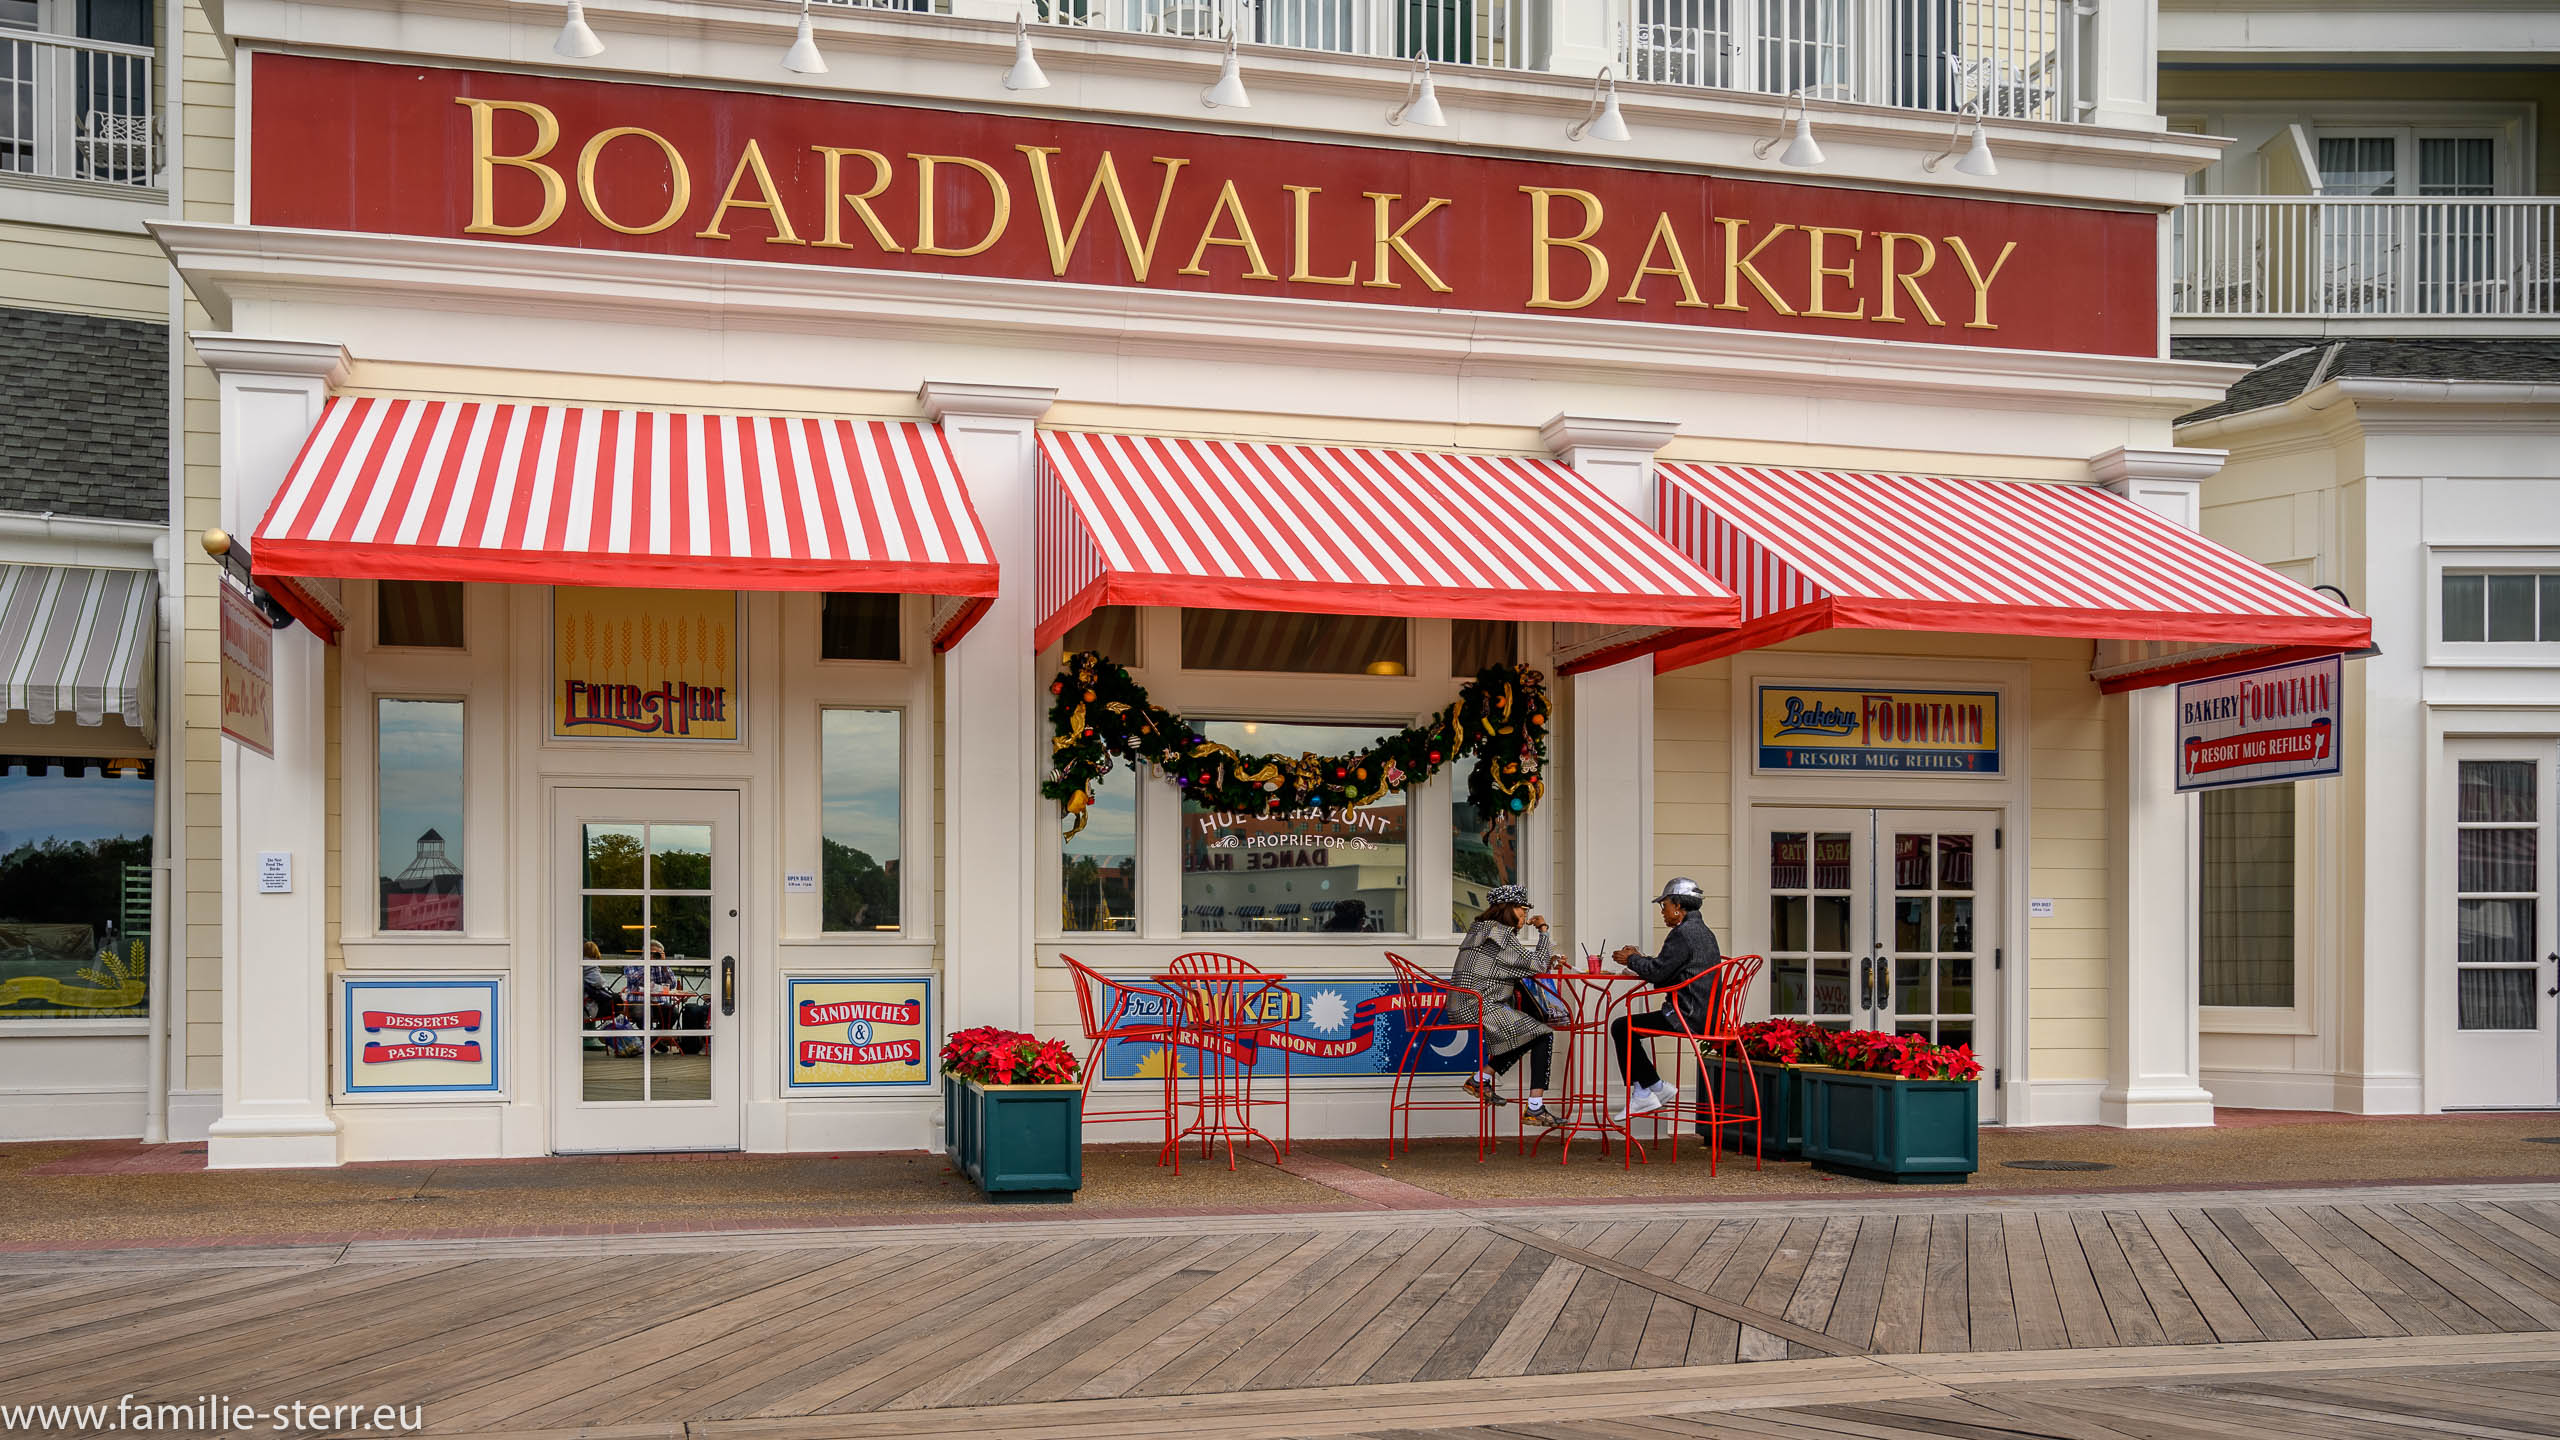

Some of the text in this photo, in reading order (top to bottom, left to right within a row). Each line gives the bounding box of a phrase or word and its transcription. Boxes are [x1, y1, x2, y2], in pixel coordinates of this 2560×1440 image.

[455, 96, 2018, 330] BOARDWALK BAKERY
[565, 680, 726, 734] ENTER HERE
[2184, 672, 2330, 728] BAKERY FOUNTAIN
[1774, 695, 1983, 746] Bakery FOUNTAIN
[2201, 734, 2312, 764] RESORT MUG REFILLS
[1800, 752, 1963, 768] RESORT MUG REFILLS
[1247, 834, 1345, 849] PROPRIETOR
[1119, 989, 1180, 1018] Fresh
[385, 1015, 459, 1027] DESSERTS
[809, 1004, 910, 1023] SANDWICHES
[418, 1031, 428, 1042] &
[855, 1024, 866, 1040] &
[388, 1046, 458, 1059] PASTRIES
[807, 1043, 913, 1062] FRESH SALADS
[1269, 1033, 1316, 1055] NOON
[1323, 1040, 1357, 1057] AND
